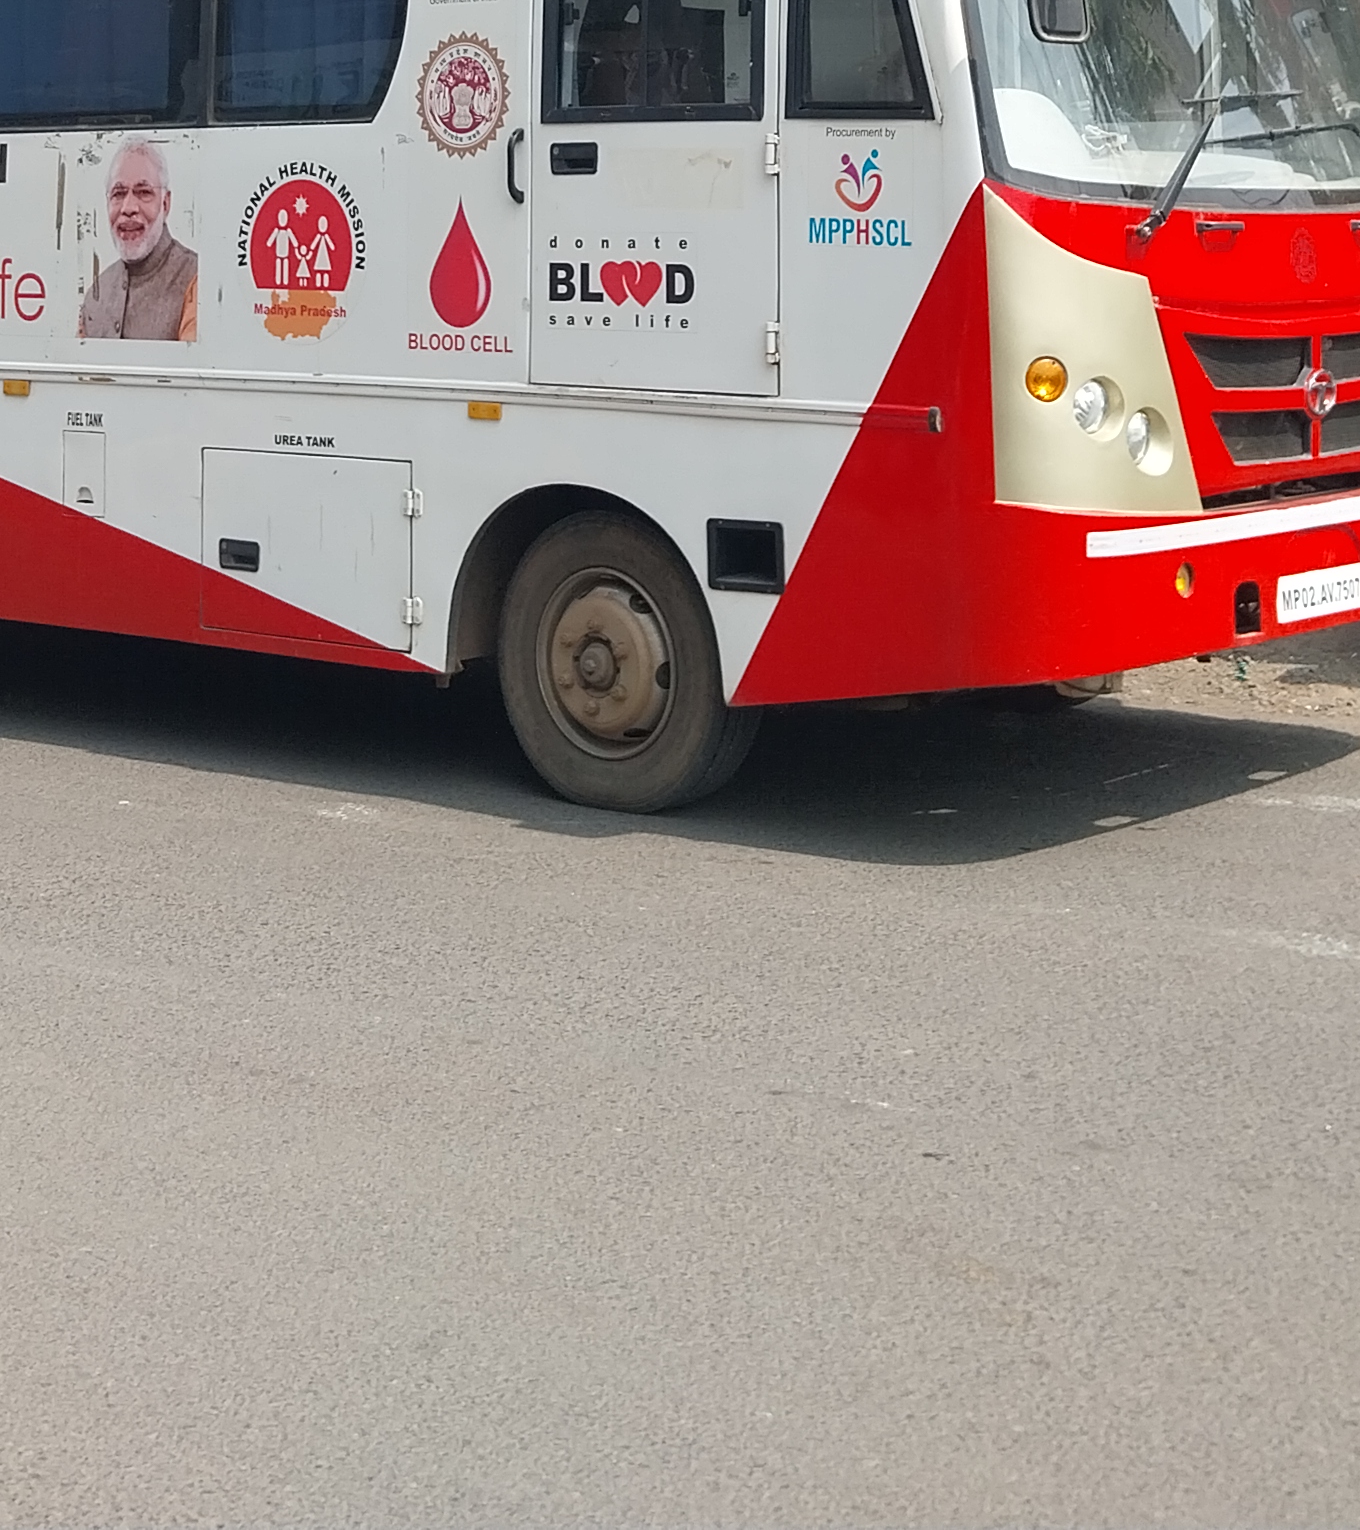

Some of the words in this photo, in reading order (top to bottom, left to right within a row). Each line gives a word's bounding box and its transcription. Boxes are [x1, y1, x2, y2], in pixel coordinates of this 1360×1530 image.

[826, 126, 883, 138] Procurement
[884, 127, 896, 140] by
[237, 176, 277, 267] NATIONAL
[278, 161, 338, 188] HEALTH
[337, 184, 367, 270] MISSION
[808, 217, 913, 247] MPPHSCL
[254, 303, 297, 319] Madhya
[300, 305, 347, 318] Pradesh
[548, 314, 612, 327] save
[634, 314, 689, 329] life
[408, 333, 466, 353] BLOOD
[470, 333, 513, 354] CELL
[67, 412, 83, 426] FUEL
[85, 412, 104, 427] TANK
[274, 434, 304, 446] UREA
[305, 436, 335, 449] TANK
